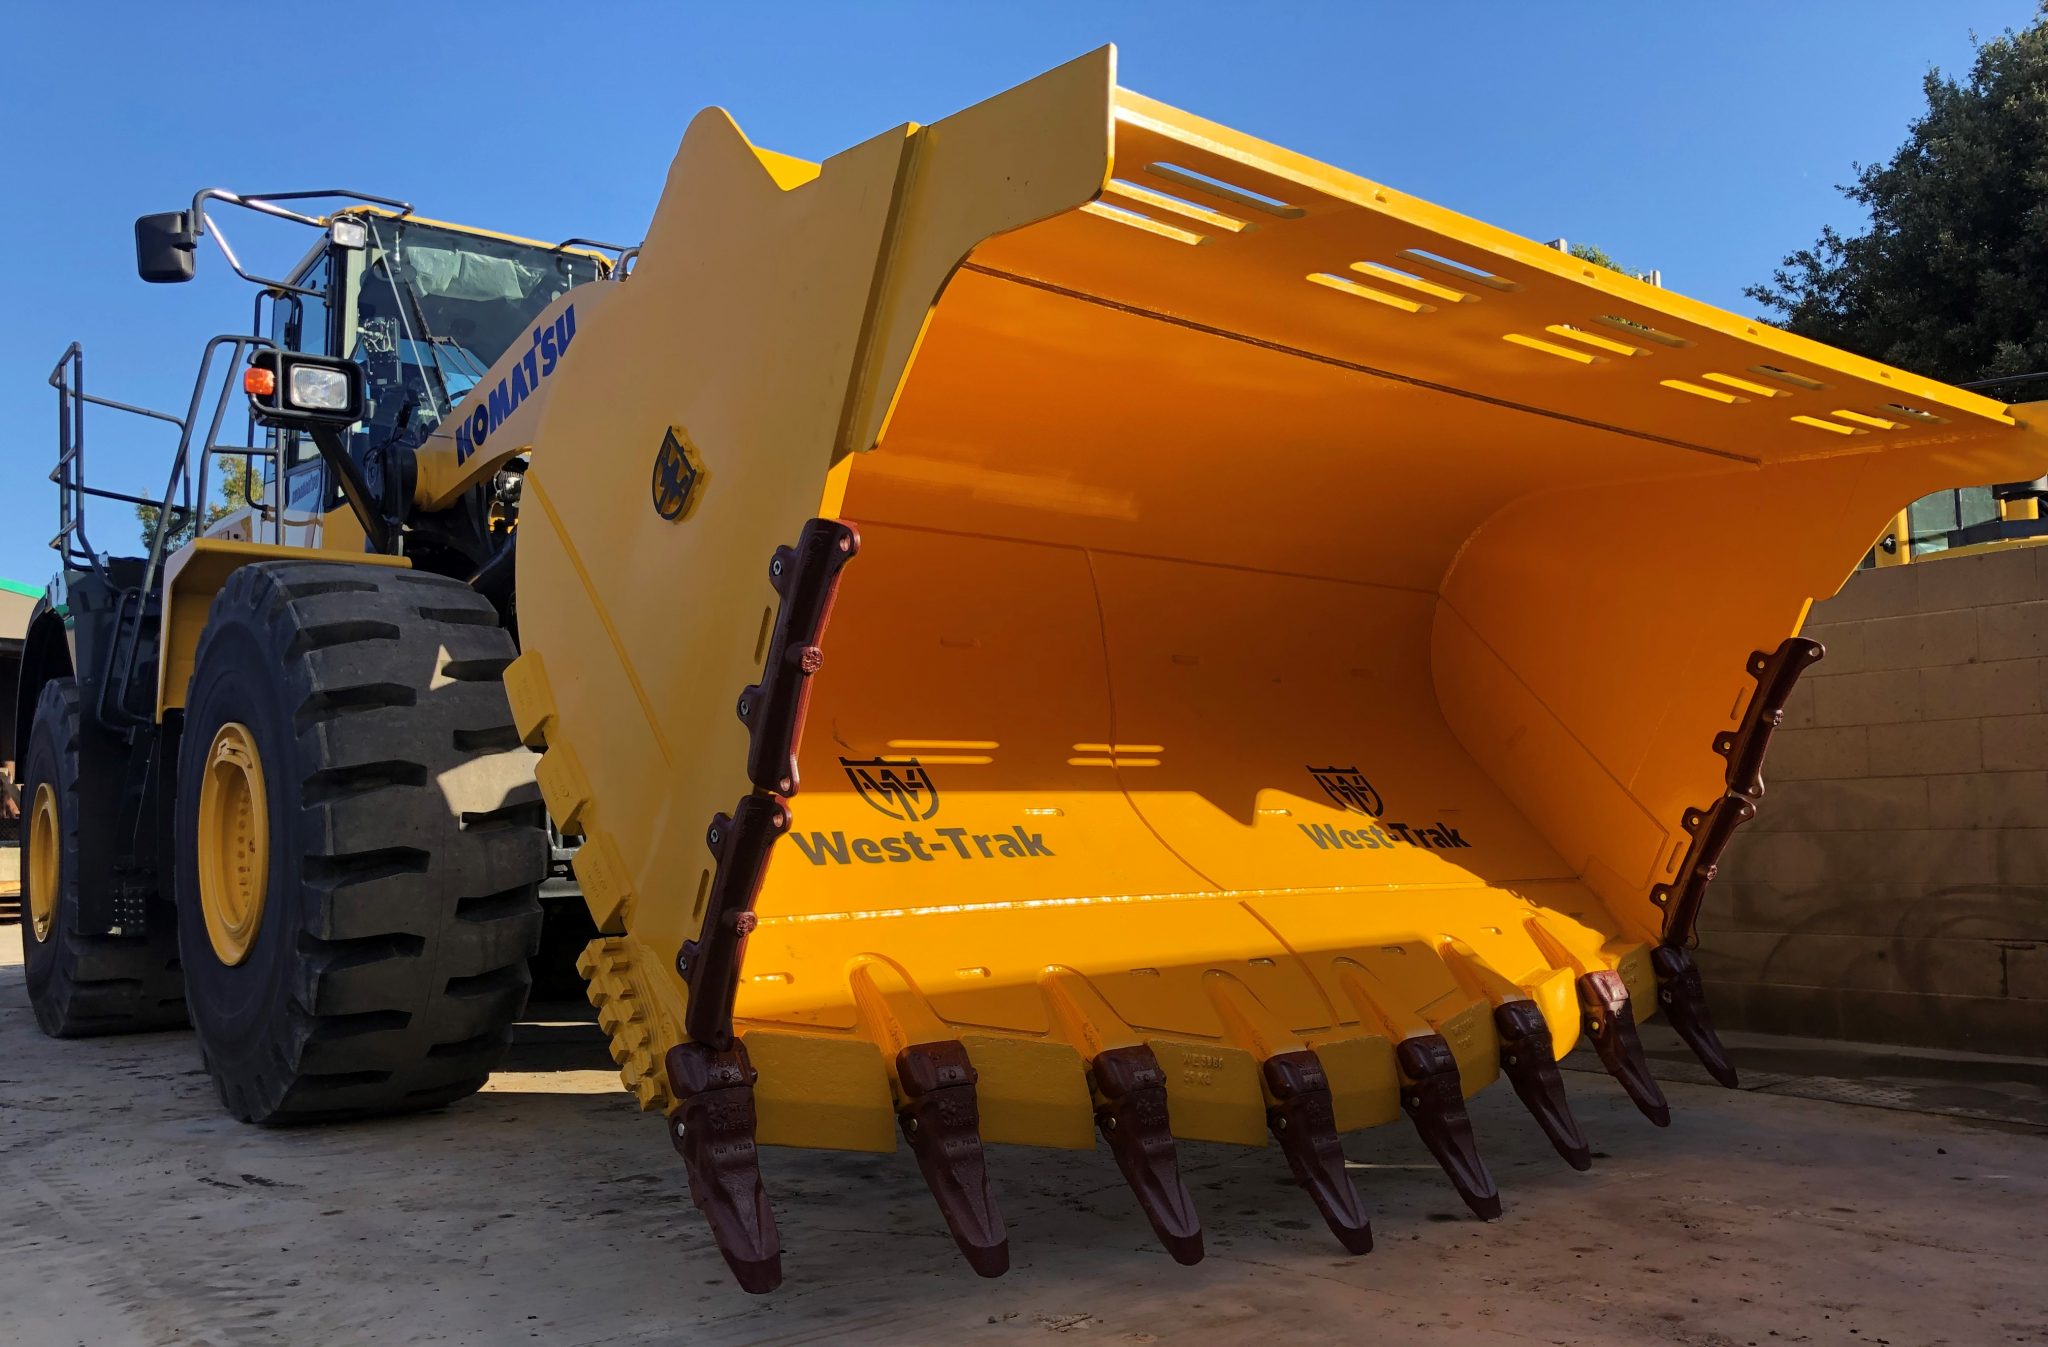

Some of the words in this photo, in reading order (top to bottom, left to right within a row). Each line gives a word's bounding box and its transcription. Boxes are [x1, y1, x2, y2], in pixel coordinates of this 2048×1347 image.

[456, 304, 576, 467] KOMATSU
[790, 825, 1056, 866] West-Trak
[1297, 822, 1472, 849] West-Trak
